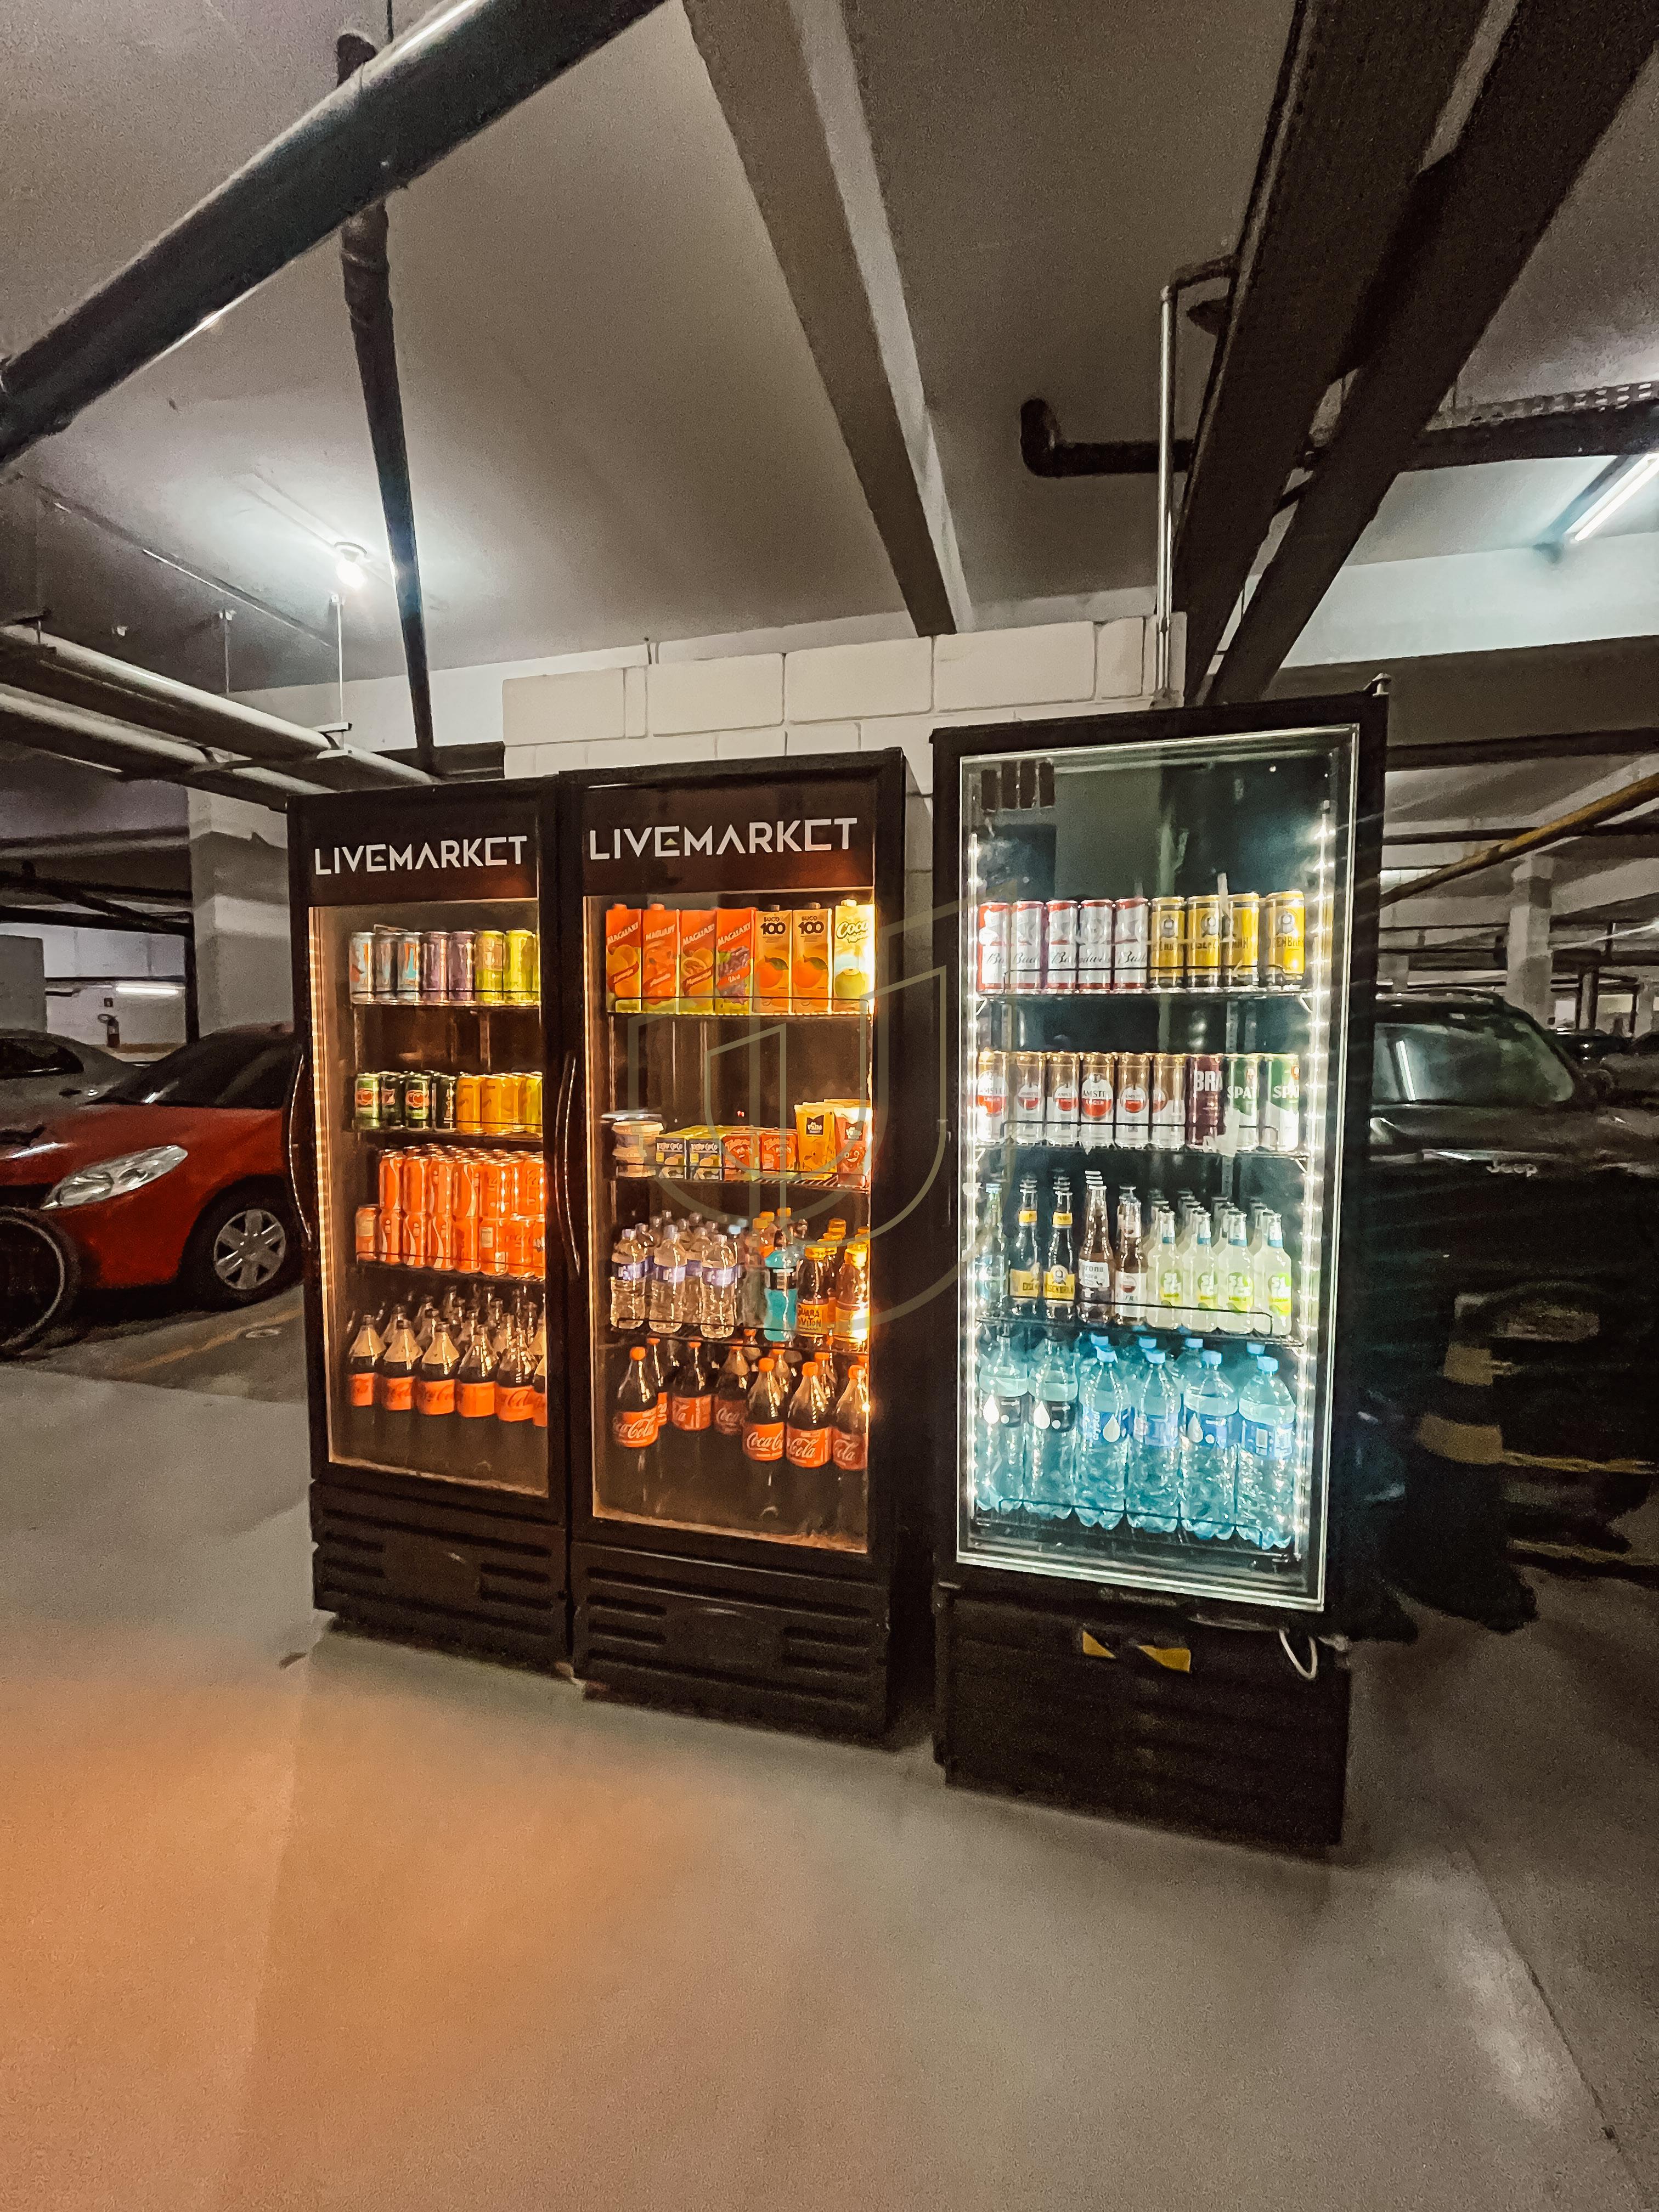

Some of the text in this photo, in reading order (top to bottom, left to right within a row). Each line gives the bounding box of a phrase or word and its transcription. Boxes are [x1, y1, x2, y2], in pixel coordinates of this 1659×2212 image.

[760, 922, 786, 935] 100
[798, 921, 825, 934] 100
[1486, 1159, 1538, 1177] Jeep
